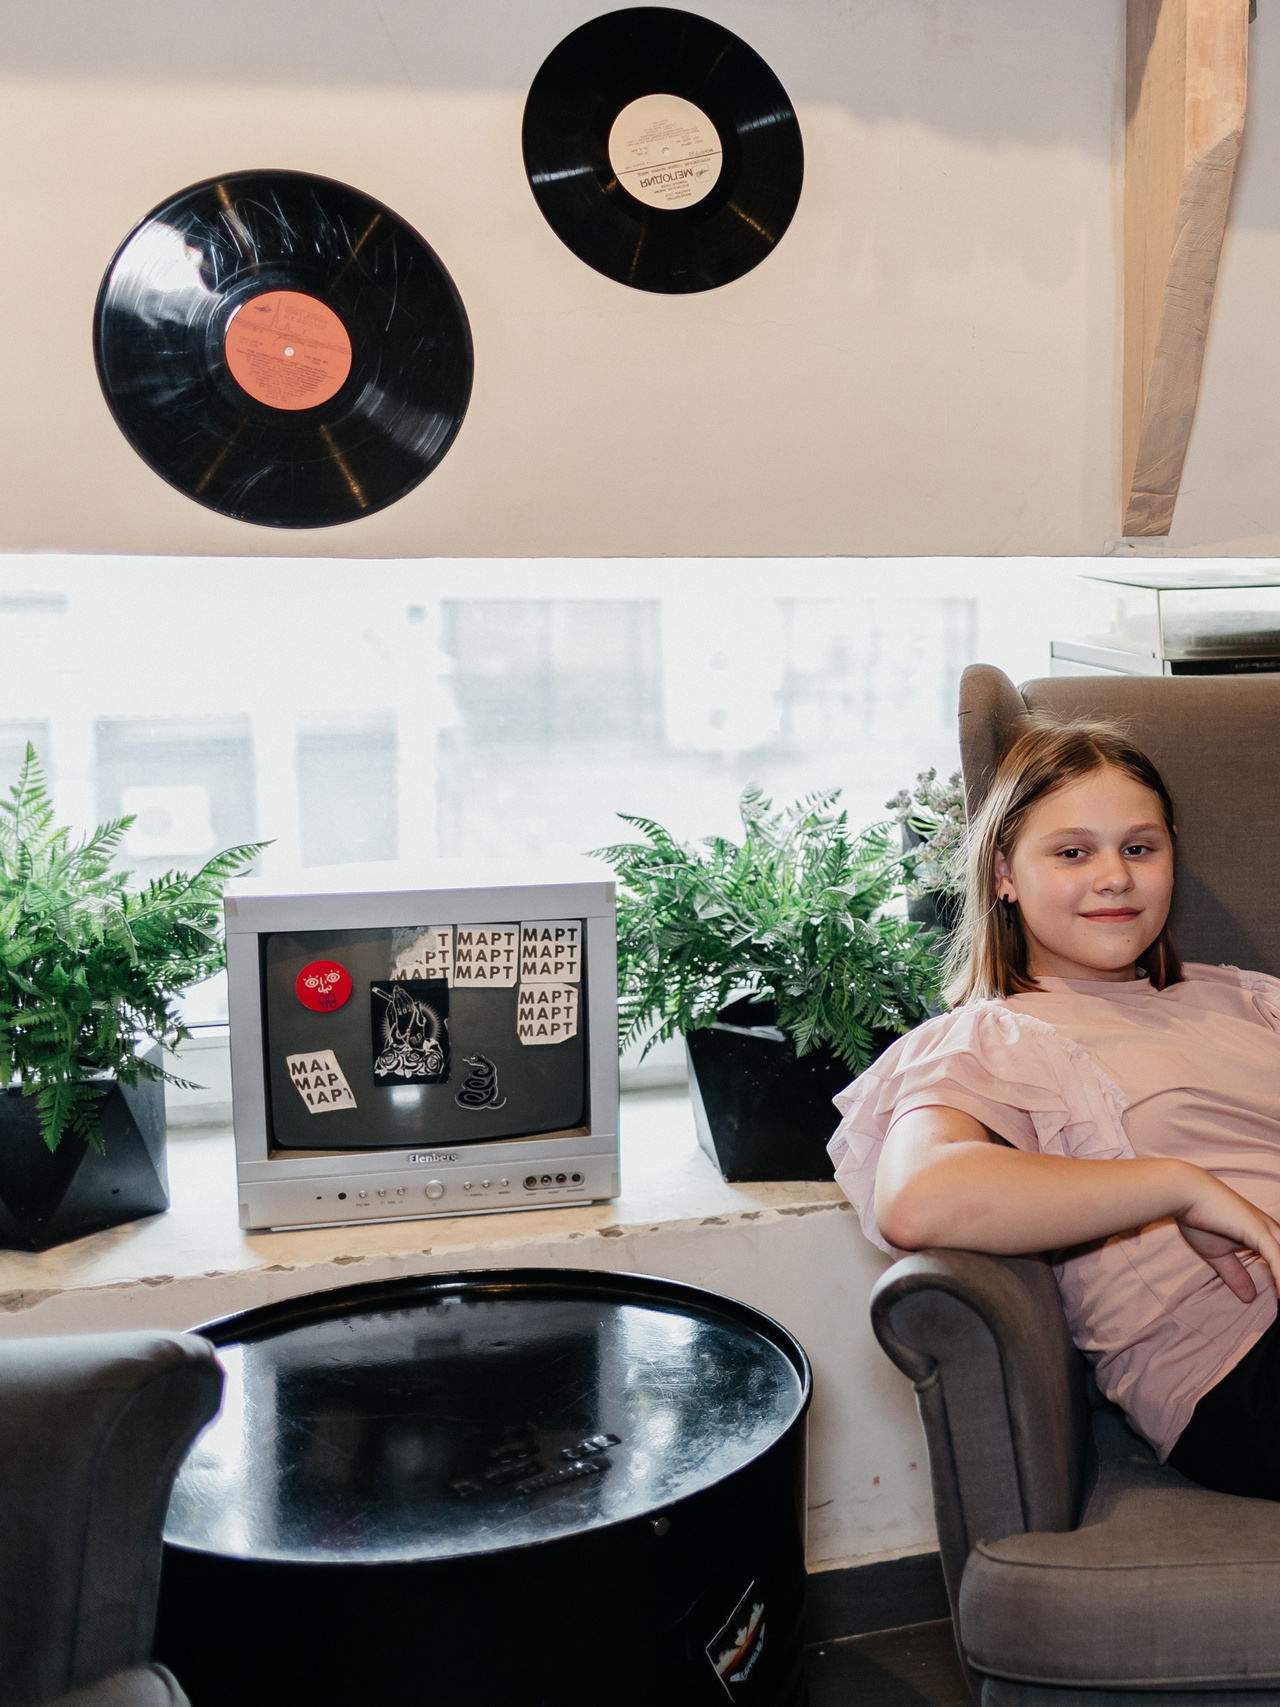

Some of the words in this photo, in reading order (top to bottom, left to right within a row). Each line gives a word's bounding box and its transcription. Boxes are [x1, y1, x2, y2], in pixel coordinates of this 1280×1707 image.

[639, 168, 694, 188] МЕЛОДИЯ
[457, 932, 515, 946] МАРТ
[522, 928, 578, 942] МАРТ
[456, 949, 514, 963] МАРТ
[521, 945, 577, 959] МАРТ
[456, 965, 514, 979] МАРТ
[521, 961, 577, 975] МАРТ
[519, 989, 574, 1005] МАРТ
[519, 1006, 573, 1021] МАРТ
[519, 1022, 573, 1037] МАРТ
[409, 1153, 458, 1163] Elenberg
